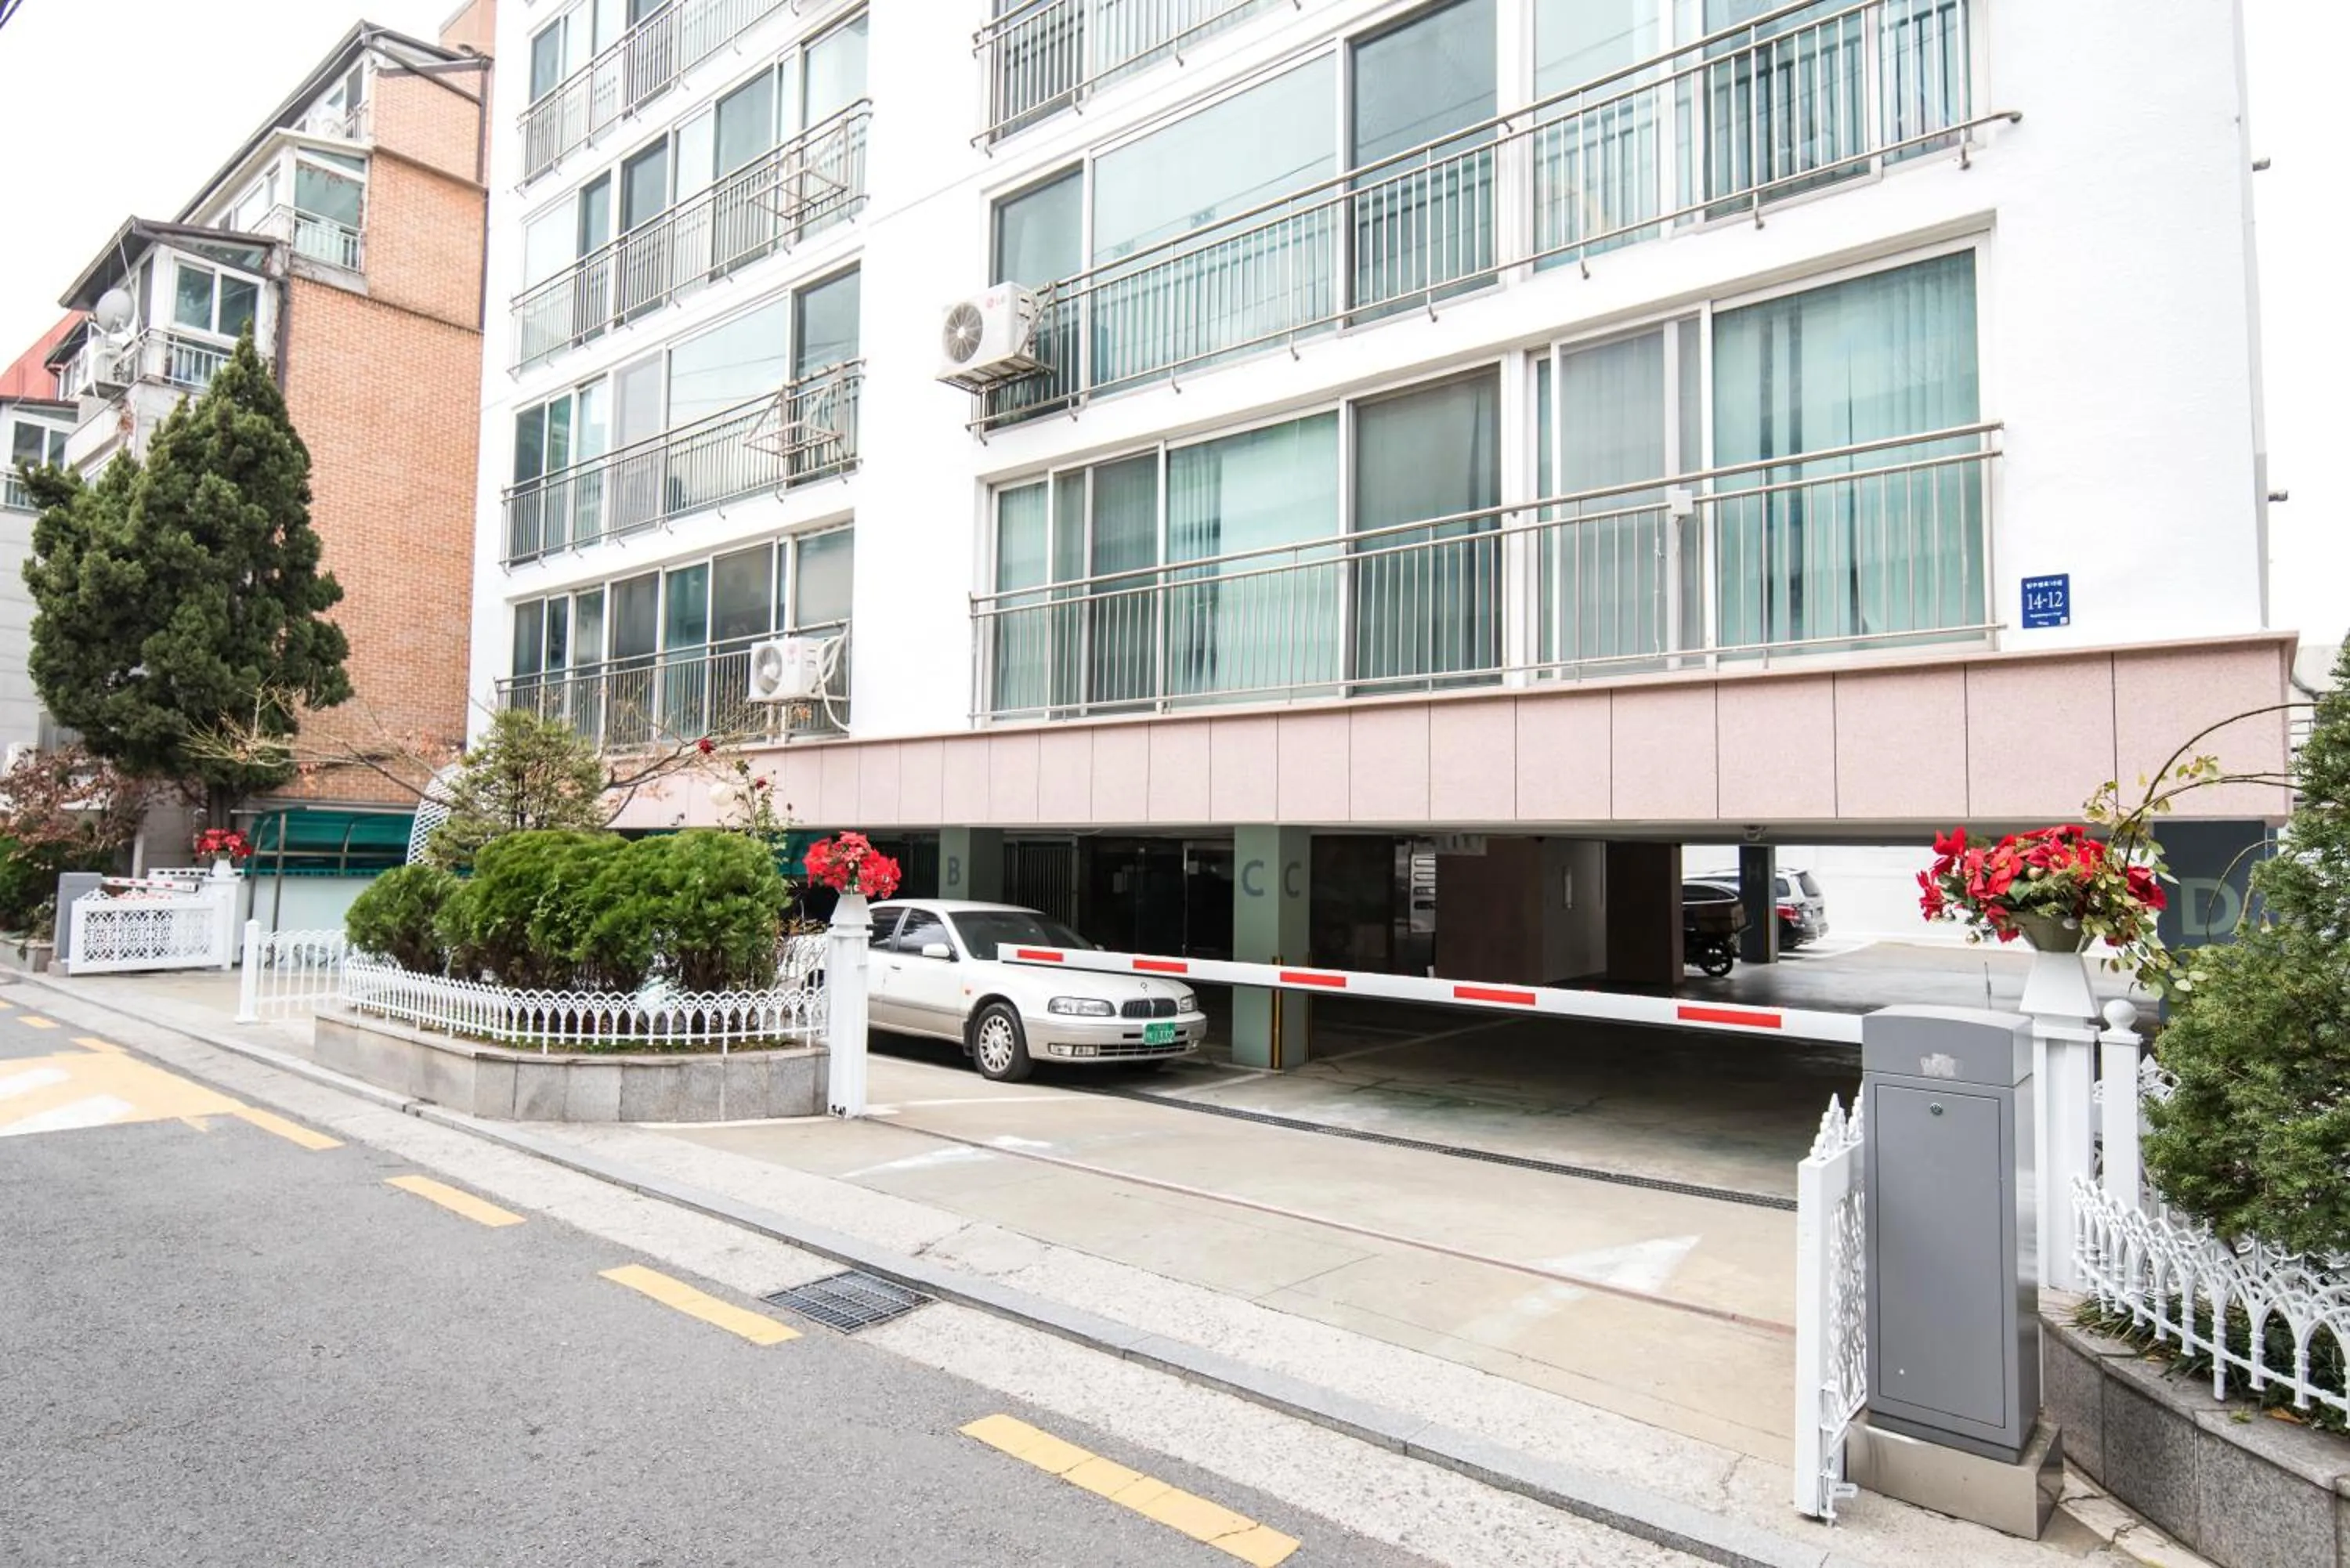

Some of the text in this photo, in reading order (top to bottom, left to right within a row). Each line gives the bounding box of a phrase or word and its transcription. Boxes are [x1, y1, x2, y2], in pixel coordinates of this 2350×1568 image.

[2027, 591, 2063, 610] 14-12
[947, 855, 960, 886] B
[1241, 858, 1265, 898] C
[1284, 861, 1302, 898] C
[2180, 876, 2241, 935] D
